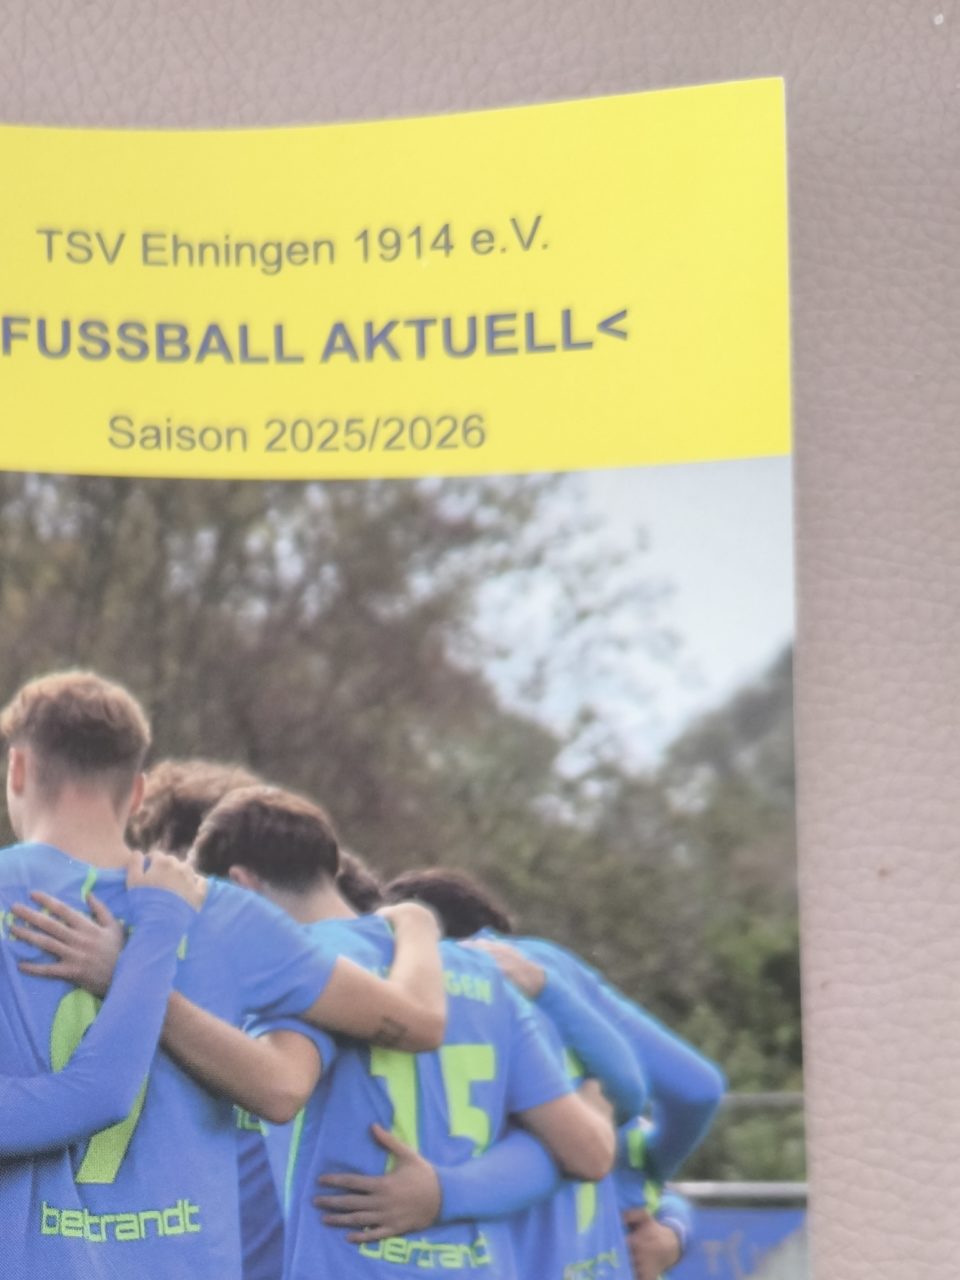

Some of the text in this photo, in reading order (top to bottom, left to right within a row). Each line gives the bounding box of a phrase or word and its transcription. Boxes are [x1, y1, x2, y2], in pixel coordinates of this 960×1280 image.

[36, 214, 550, 276] TSV Ehningen 1914 e.V.
[107, 413, 487, 453] Saison 2025/2026
[370, 1043, 496, 1175] 15
